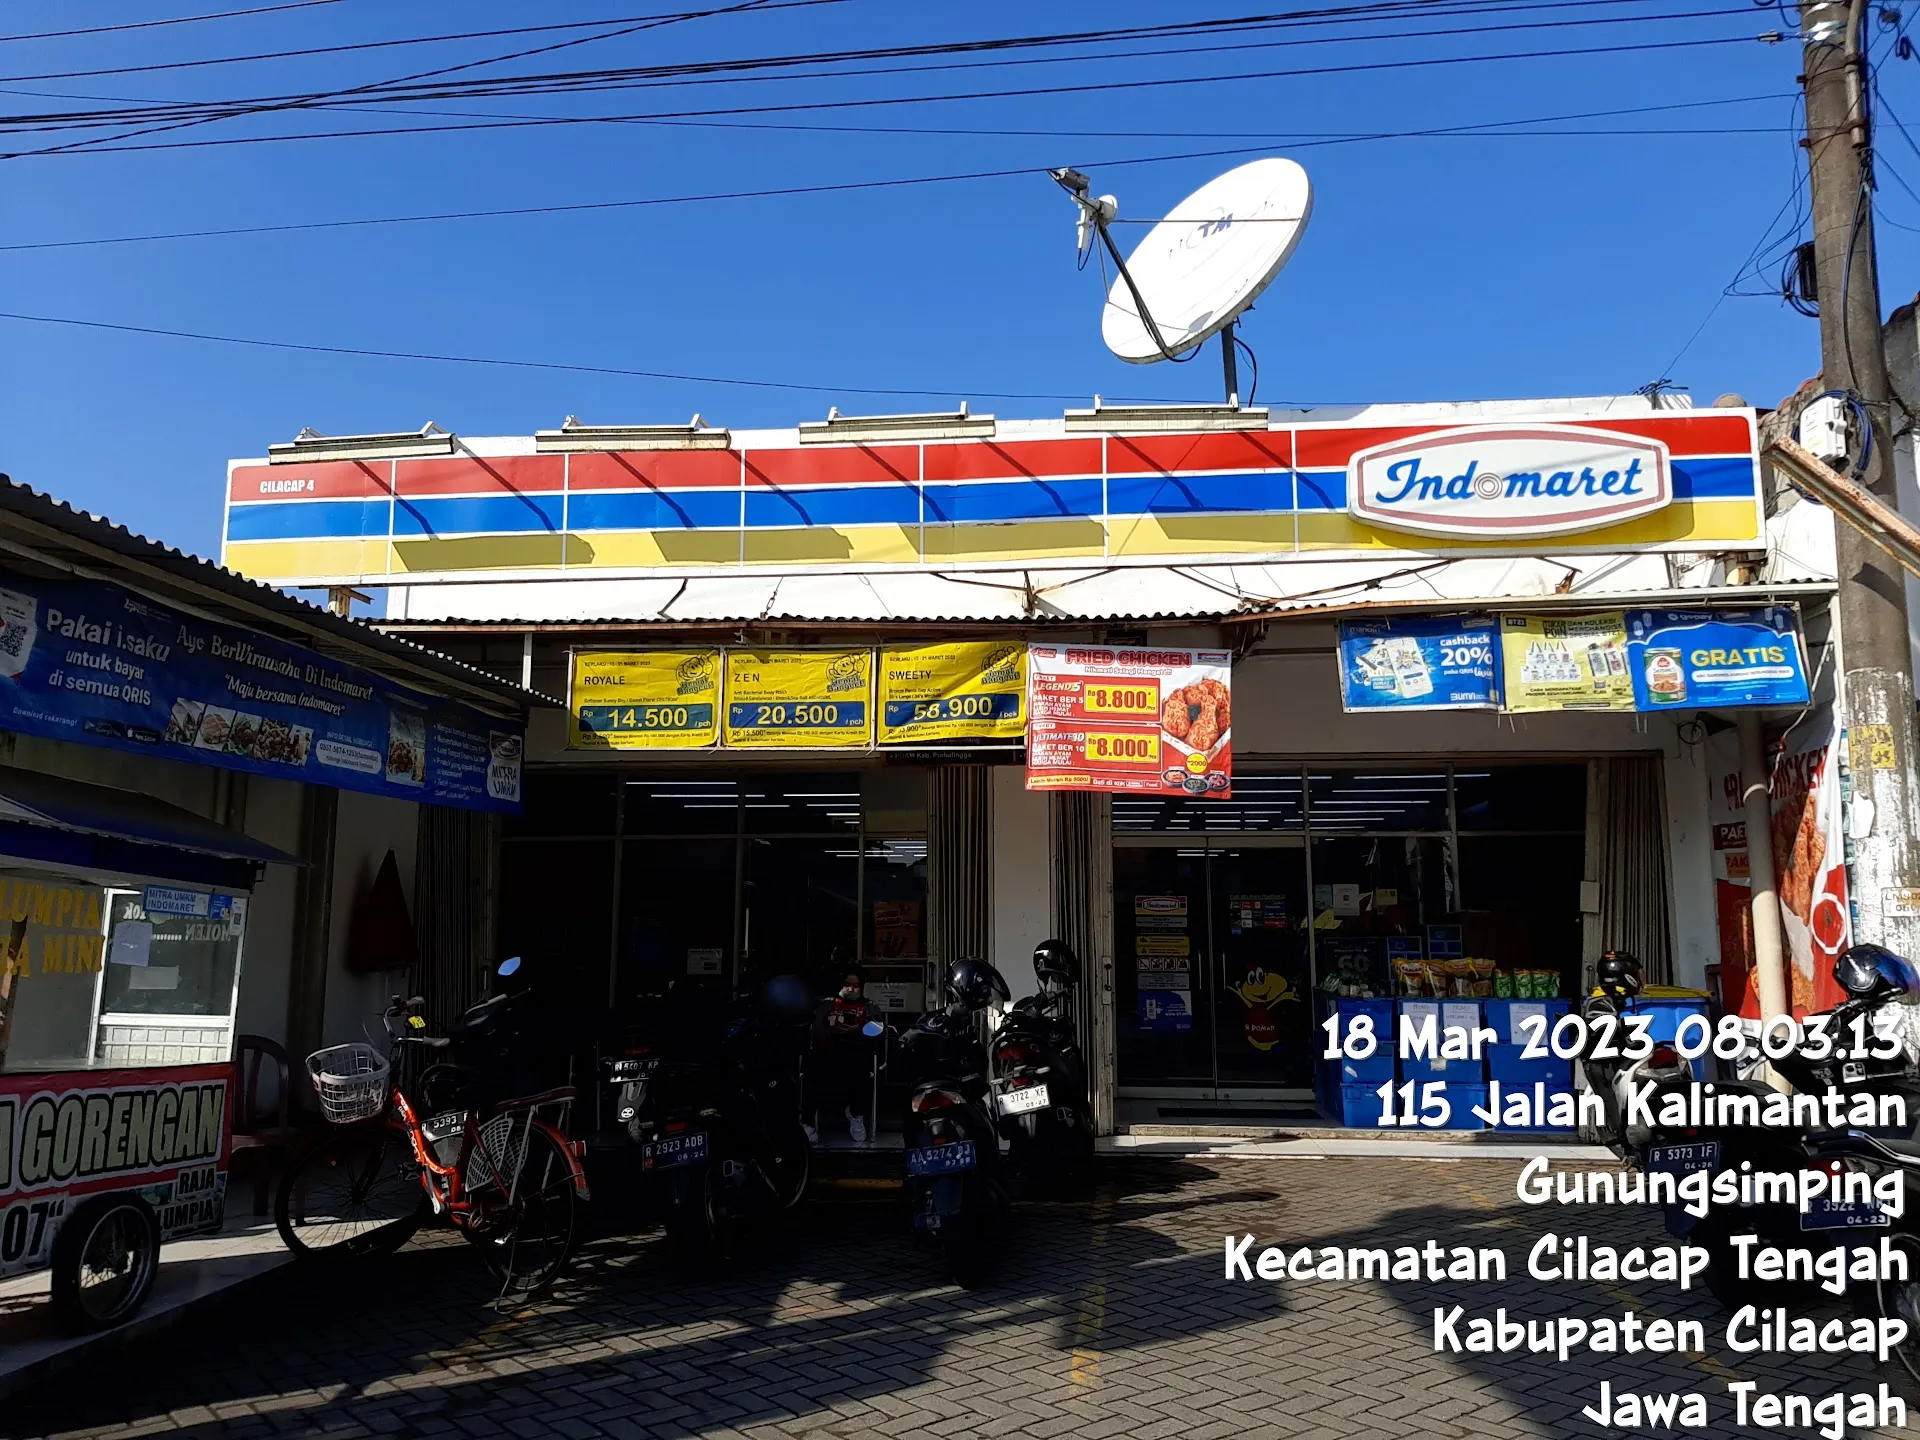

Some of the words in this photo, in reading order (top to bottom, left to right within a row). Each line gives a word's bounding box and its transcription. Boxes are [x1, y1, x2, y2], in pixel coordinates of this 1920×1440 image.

[259, 480, 305, 494] CILACAP
[306, 479, 315, 492] 4
[1375, 456, 1643, 505] Indomaret
[46, 607, 113, 647] Pakai
[115, 623, 172, 663] i.saku
[1439, 634, 1491, 647] cashback
[1544, 627, 1567, 638] POIN
[65, 649, 112, 672] untuk
[114, 656, 145, 681] bayar
[1065, 648, 1115, 665] FRIED
[1116, 650, 1193, 669] CHICKEN
[1440, 646, 1494, 667] 20%
[210, 633, 302, 681] BerWirausaha
[304, 663, 320, 686] Di
[320, 668, 375, 702] Indomaret
[889, 670, 932, 681] SWEETY
[48, 668, 64, 688] di
[65, 675, 120, 698] semua
[121, 684, 153, 707] QRIS
[584, 675, 626, 686] ROYALE
[255, 683, 298, 707] bersama
[1059, 695, 1077, 704] BER
[582, 710, 594, 718] Rp
[608, 707, 689, 730] 14.500
[757, 705, 838, 725] 20.500
[849, 718, 864, 726] pch
[888, 705, 899, 713] Rp
[1058, 744, 1074, 752] BER
[1075, 745, 1085, 753] 10
[1087, 737, 1097, 745] Rp
[916, 751, 930, 760] Kab.
[148, 888, 173, 900] MITRA
[174, 892, 197, 903] UMKM
[148, 899, 196, 913] INDOMARET
[41, 934, 105, 974] MINI
[999, 1097, 1004, 1106] R
[1010, 1090, 1030, 1103] 3722
[1034, 1087, 1045, 1097] XF
[433, 1115, 457, 1129] 5393
[19, 1085, 225, 1187] GORENGAN
[645, 1146, 652, 1158] R
[656, 1139, 681, 1155] 2923
[1654, 1150, 1661, 1162] R
[1667, 1147, 1694, 1161] 5373
[1700, 1145, 1714, 1158] IF
[178, 1167, 215, 1195] RAJA
[157, 1199, 214, 1230] UMPIA
